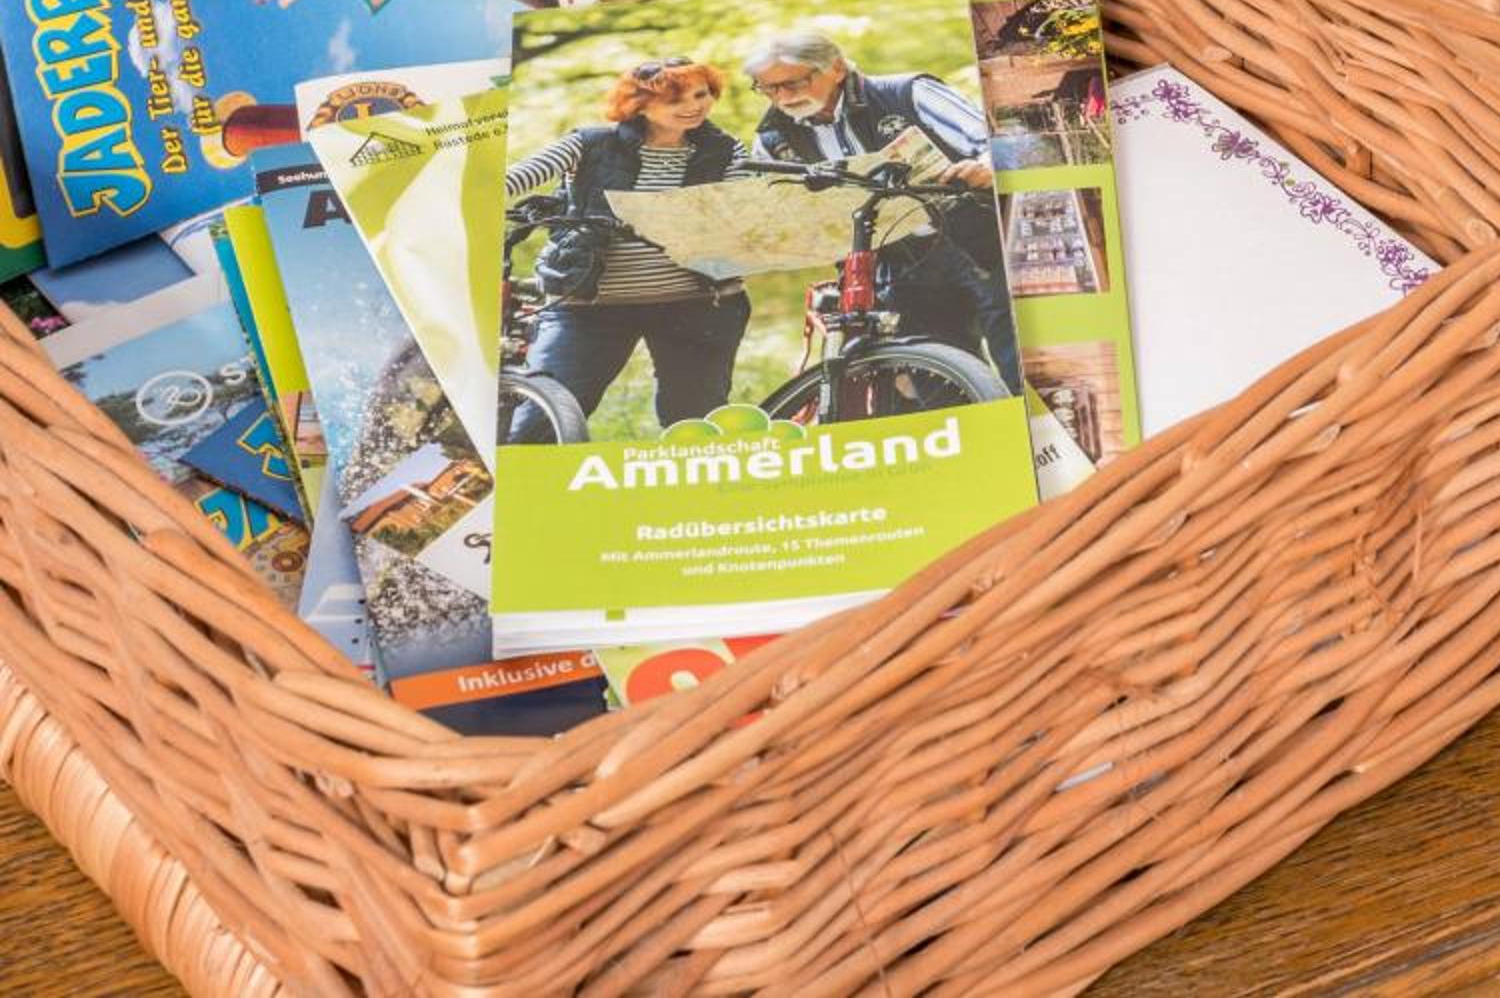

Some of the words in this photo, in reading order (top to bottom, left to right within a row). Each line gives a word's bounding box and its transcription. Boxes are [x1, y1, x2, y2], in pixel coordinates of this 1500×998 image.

[126, 0, 159, 50] und
[147, 57, 175, 122] Tier-
[177, 46, 207, 93] die
[190, 96, 222, 138] für
[160, 128, 188, 176] Der
[567, 417, 962, 492] Ammerland
[636, 506, 887, 542] Radübersichtskarte
[457, 658, 574, 693] Inklusive
